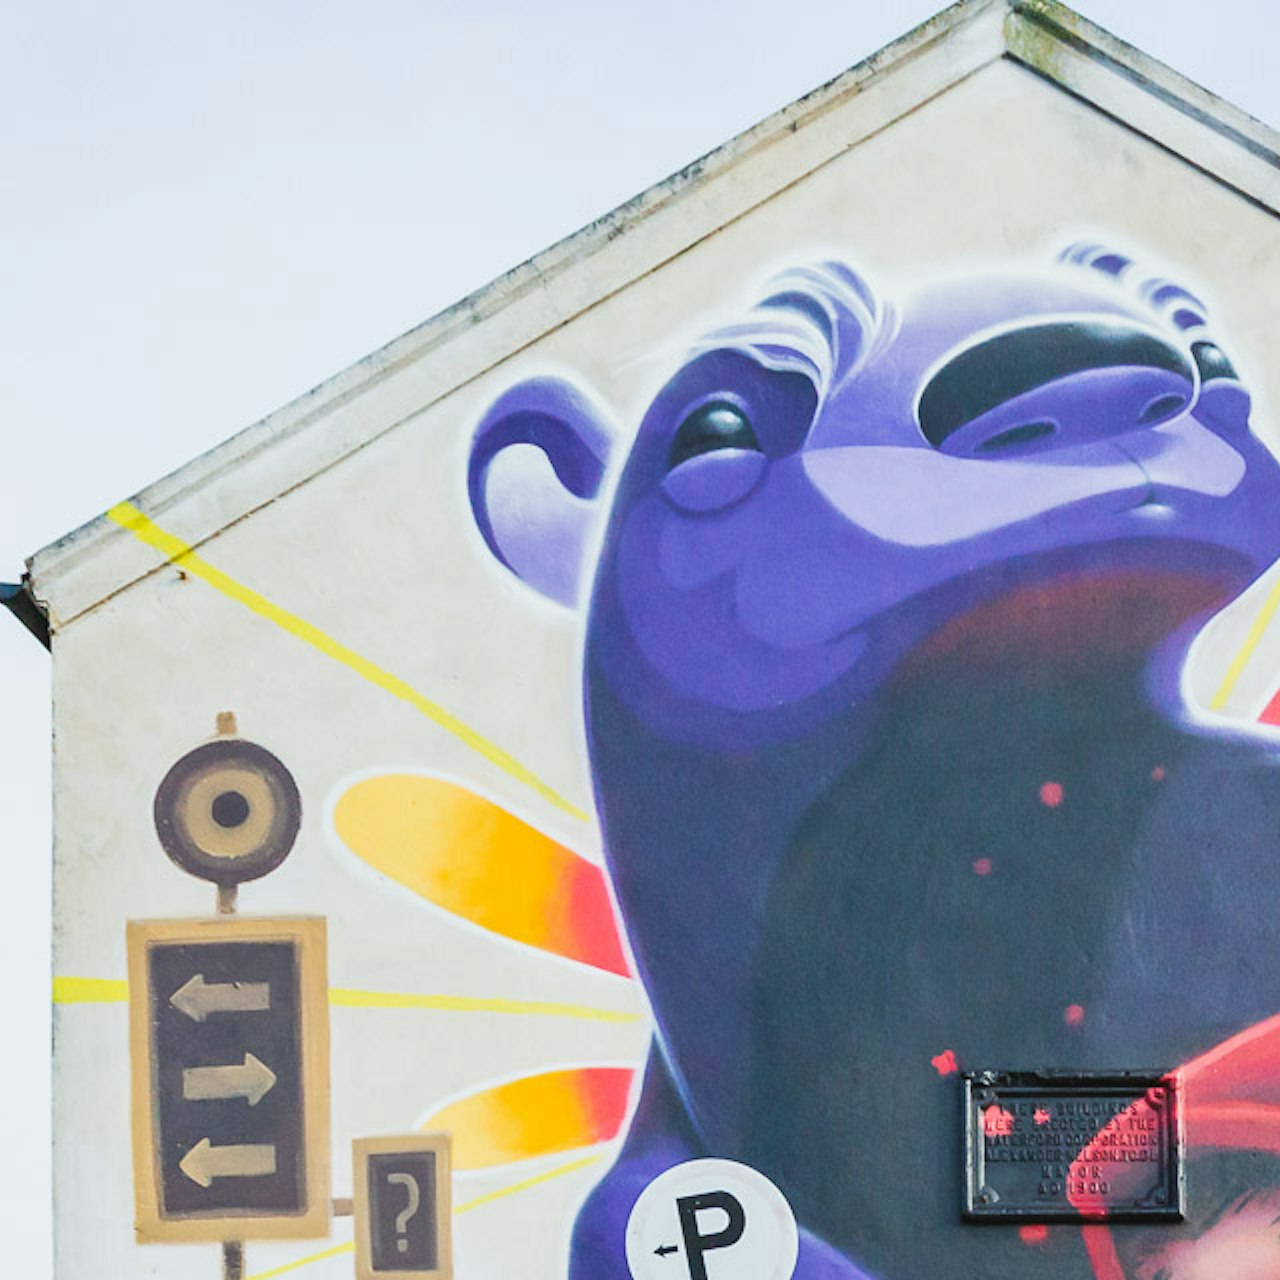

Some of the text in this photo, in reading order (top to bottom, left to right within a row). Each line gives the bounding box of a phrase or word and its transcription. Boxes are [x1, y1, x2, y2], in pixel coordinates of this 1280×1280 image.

[1057, 1102, 1139, 1117] BUILDINGS
[1128, 1117, 1157, 1132] THE
[985, 1149, 1064, 1163] ALEXANDER
[1041, 1164, 1103, 1179] MAYOR
[1069, 1181, 1111, 1195] 1900
[387, 1173, 420, 1253] ?
